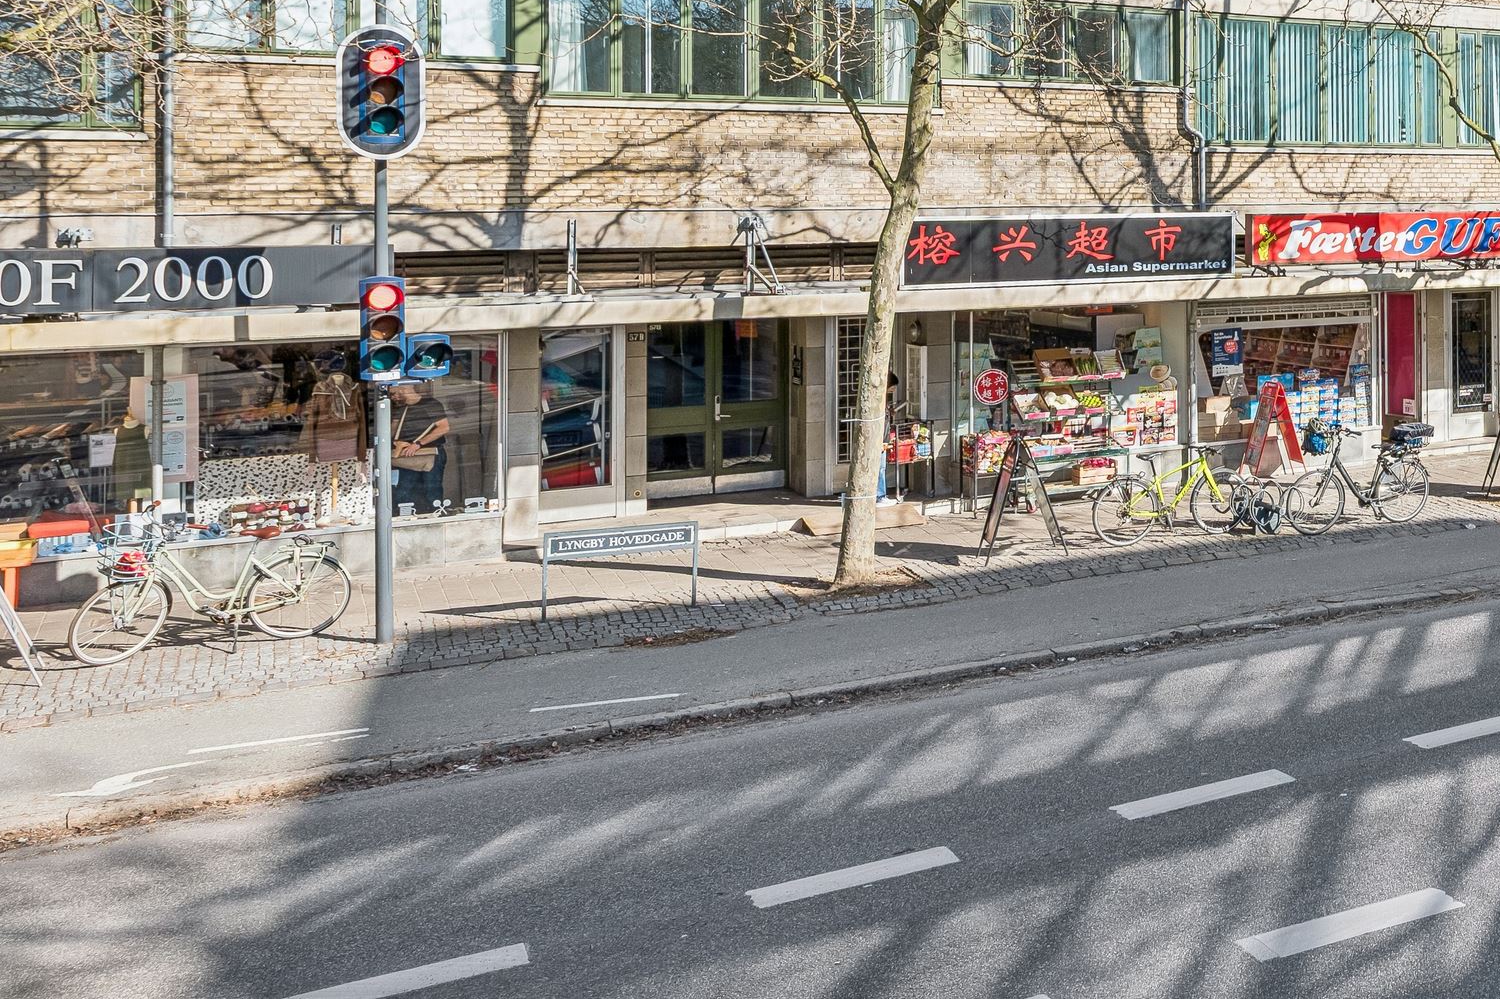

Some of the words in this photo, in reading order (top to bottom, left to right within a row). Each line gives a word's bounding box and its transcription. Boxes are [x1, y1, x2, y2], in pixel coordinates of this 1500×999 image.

[907, 219, 1182, 266] 榕兴超市
[113, 255, 273, 303] 2000
[1085, 262, 1129, 274] Asian
[1132, 259, 1227, 275] Supermarket
[558, 537, 605, 551] LYNGBY
[609, 531, 685, 547] HOVEDGADE
